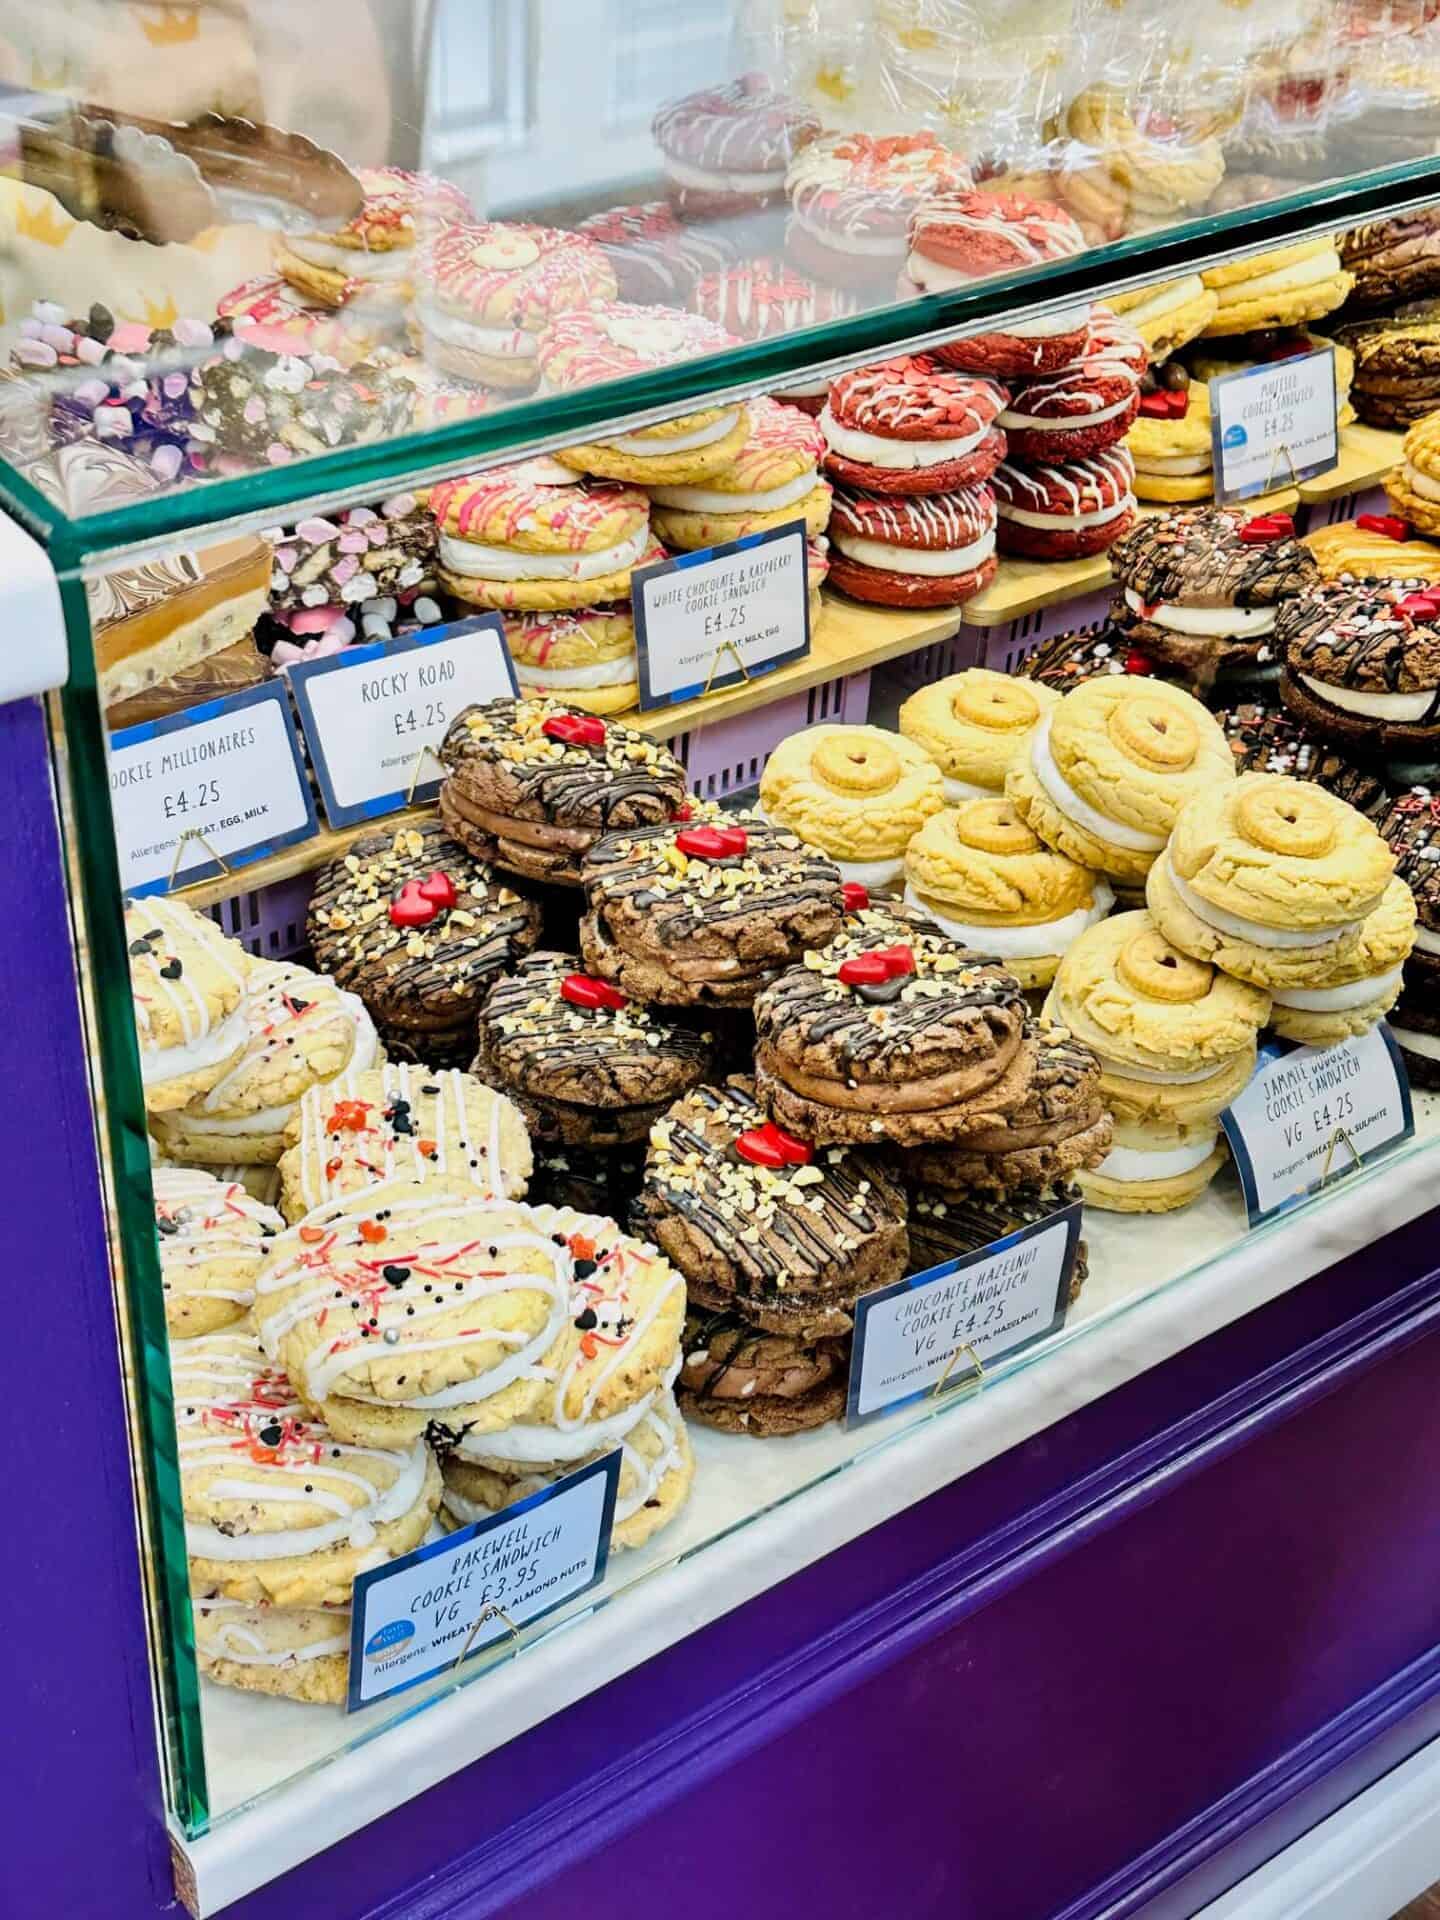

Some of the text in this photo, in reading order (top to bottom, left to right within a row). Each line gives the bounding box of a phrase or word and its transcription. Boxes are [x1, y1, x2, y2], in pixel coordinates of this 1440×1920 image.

[1264, 412, 1294, 438] £4.25
[653, 554, 792, 608] WHITE CHOCOLATE & RASPBERRY
[685, 578, 766, 615] COOKIE SANDWICH
[704, 605, 746, 637] £4.25
[362, 660, 455, 703] ROCKY ROAD
[394, 702, 446, 735] £4.25
[111, 727, 256, 790] OOKIE MILLIONAIRES
[164, 780, 220, 819] £4.25
[244, 804, 269, 820] MILK
[1263, 1062, 1308, 1101] JAMMIE
[1266, 1056, 1361, 1122] COOKIE SANDWICH
[1283, 1091, 1353, 1148] VG £4.25
[1355, 1107, 1388, 1133] SULPHITE
[895, 1247, 1039, 1322] CHOCOALTE HAZELNUT
[902, 1270, 1029, 1337] COOKIE SANDWICH
[914, 1300, 1007, 1356] VG £4.25
[993, 1307, 1040, 1336] HAZELNUT
[410, 1525, 562, 1614] COOKIE SANDWICH
[451, 1523, 528, 1576] BAKEWELL
[434, 1559, 539, 1629] VG £3.95
[511, 1576, 558, 1607] ALMOND
[559, 1558, 587, 1580] NUTS
